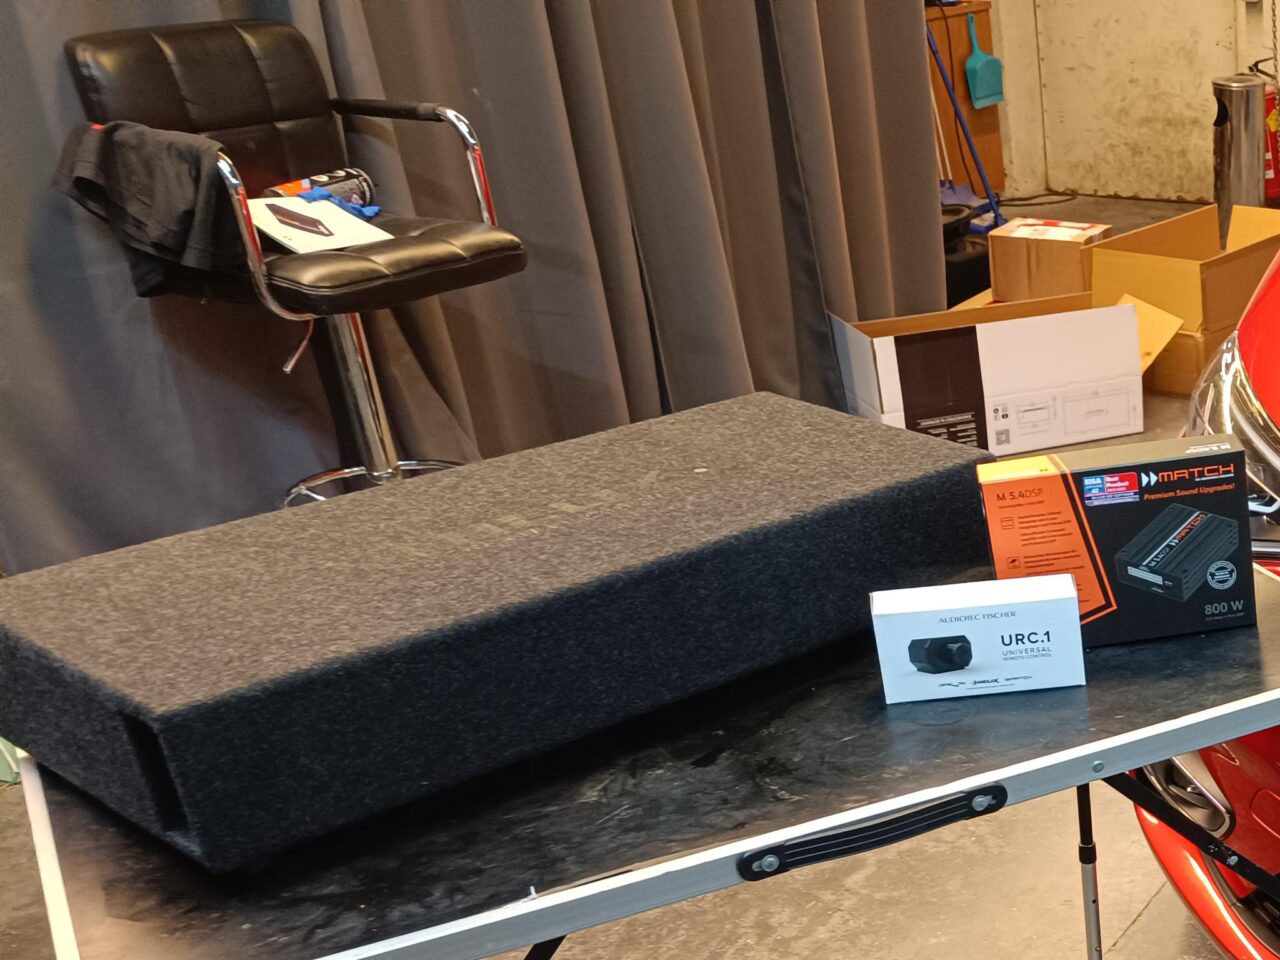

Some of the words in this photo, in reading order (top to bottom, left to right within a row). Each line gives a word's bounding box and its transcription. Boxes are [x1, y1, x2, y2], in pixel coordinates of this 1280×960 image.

[1158, 463, 1235, 483] MATCH
[996, 493, 1006, 502] M
[1143, 489, 1175, 501] Premium
[1176, 486, 1199, 496] Sound
[1204, 602, 1228, 615] 800
[1230, 599, 1244, 611] W
[938, 614, 981, 624] AUDIOTEC
[982, 610, 1017, 620] FISCHER
[1000, 630, 1052, 647] URC.1
[1002, 646, 1052, 656] UNIVERSAL
